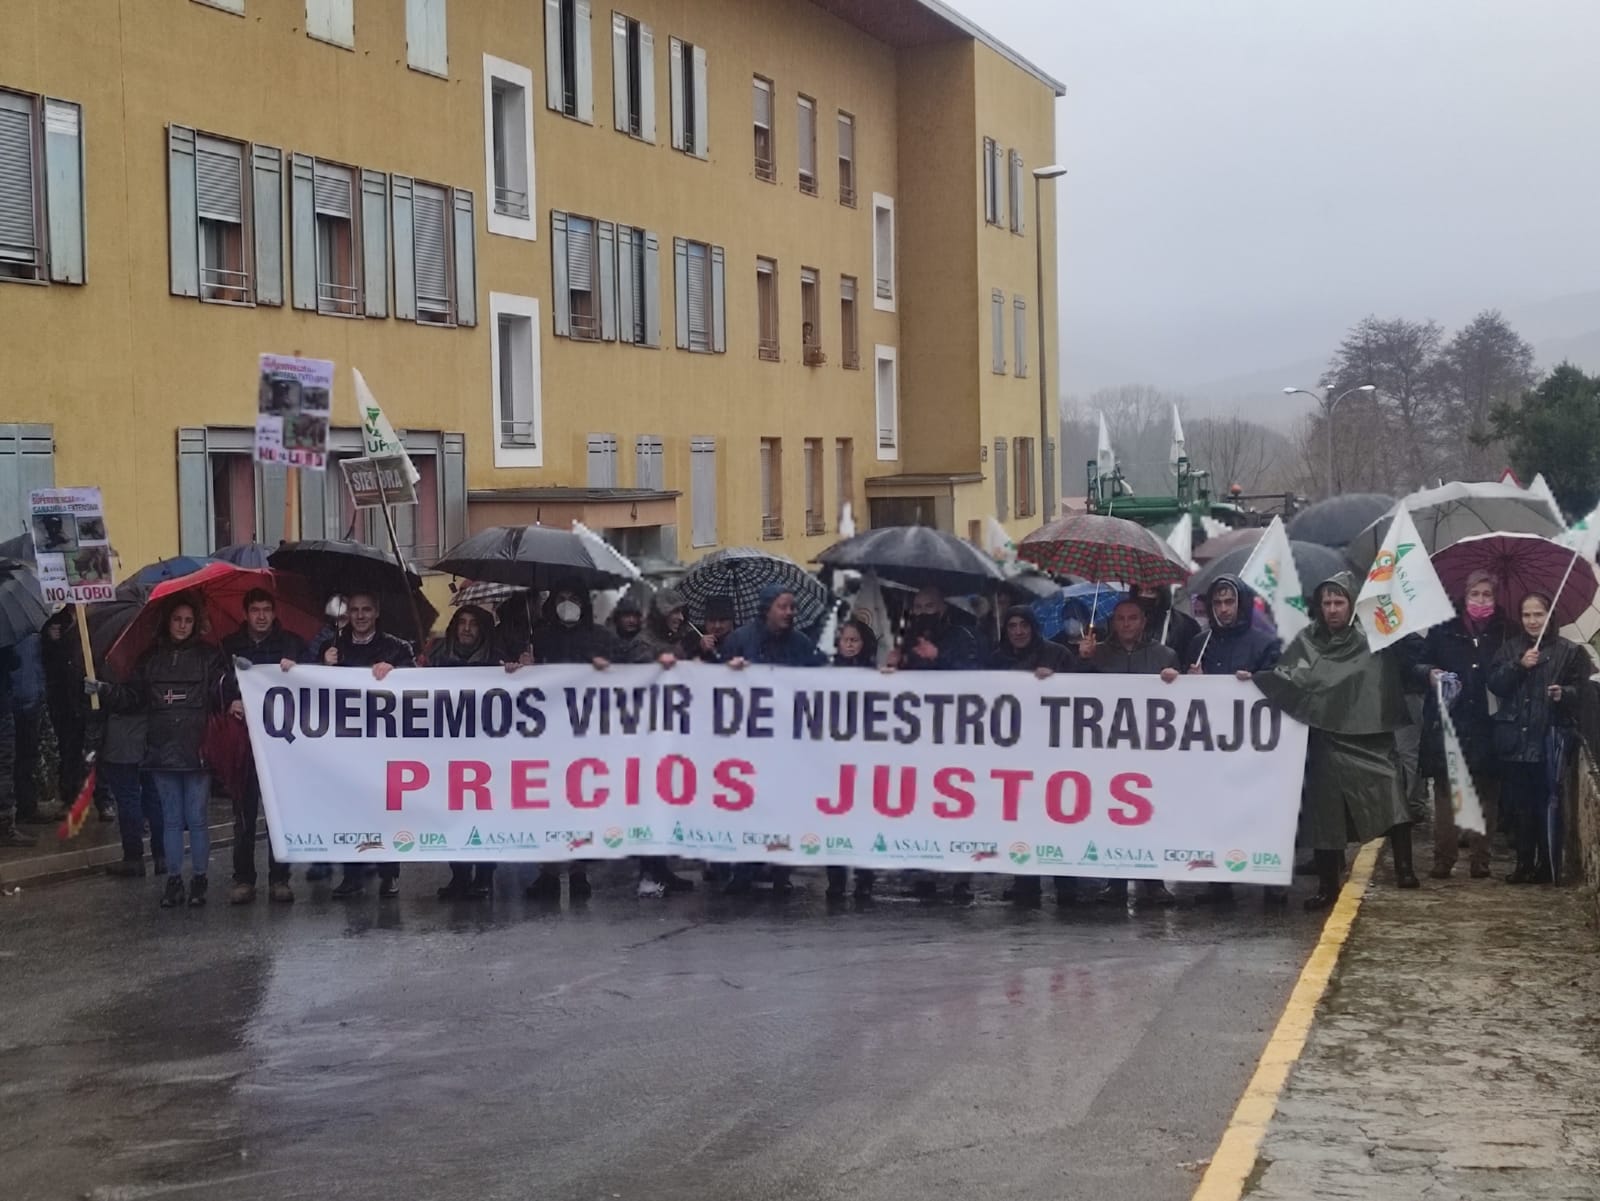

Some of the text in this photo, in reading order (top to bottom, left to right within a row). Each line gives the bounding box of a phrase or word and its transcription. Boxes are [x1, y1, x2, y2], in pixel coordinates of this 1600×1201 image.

[46, 588, 65, 601] NO
[74, 586, 112, 600] LOBO
[1395, 565, 1417, 602] ASAJA
[262, 684, 1281, 752] QUEREMOS VIVIR DE NUESTRO TRABAJO
[386, 754, 1155, 826] PRECIOS JUSTOS
[284, 832, 324, 845] SAJA
[333, 832, 382, 847] COAG
[419, 833, 447, 845] UPA
[485, 831, 536, 844] ASAJA
[628, 827, 654, 840] UPA
[826, 837, 853, 849] UPA
[892, 839, 940, 853] ASAJA
[1035, 845, 1064, 858] UPA
[1103, 848, 1154, 862] ASAJA
[1164, 849, 1214, 864] COAG
[1252, 852, 1281, 865] UPA
